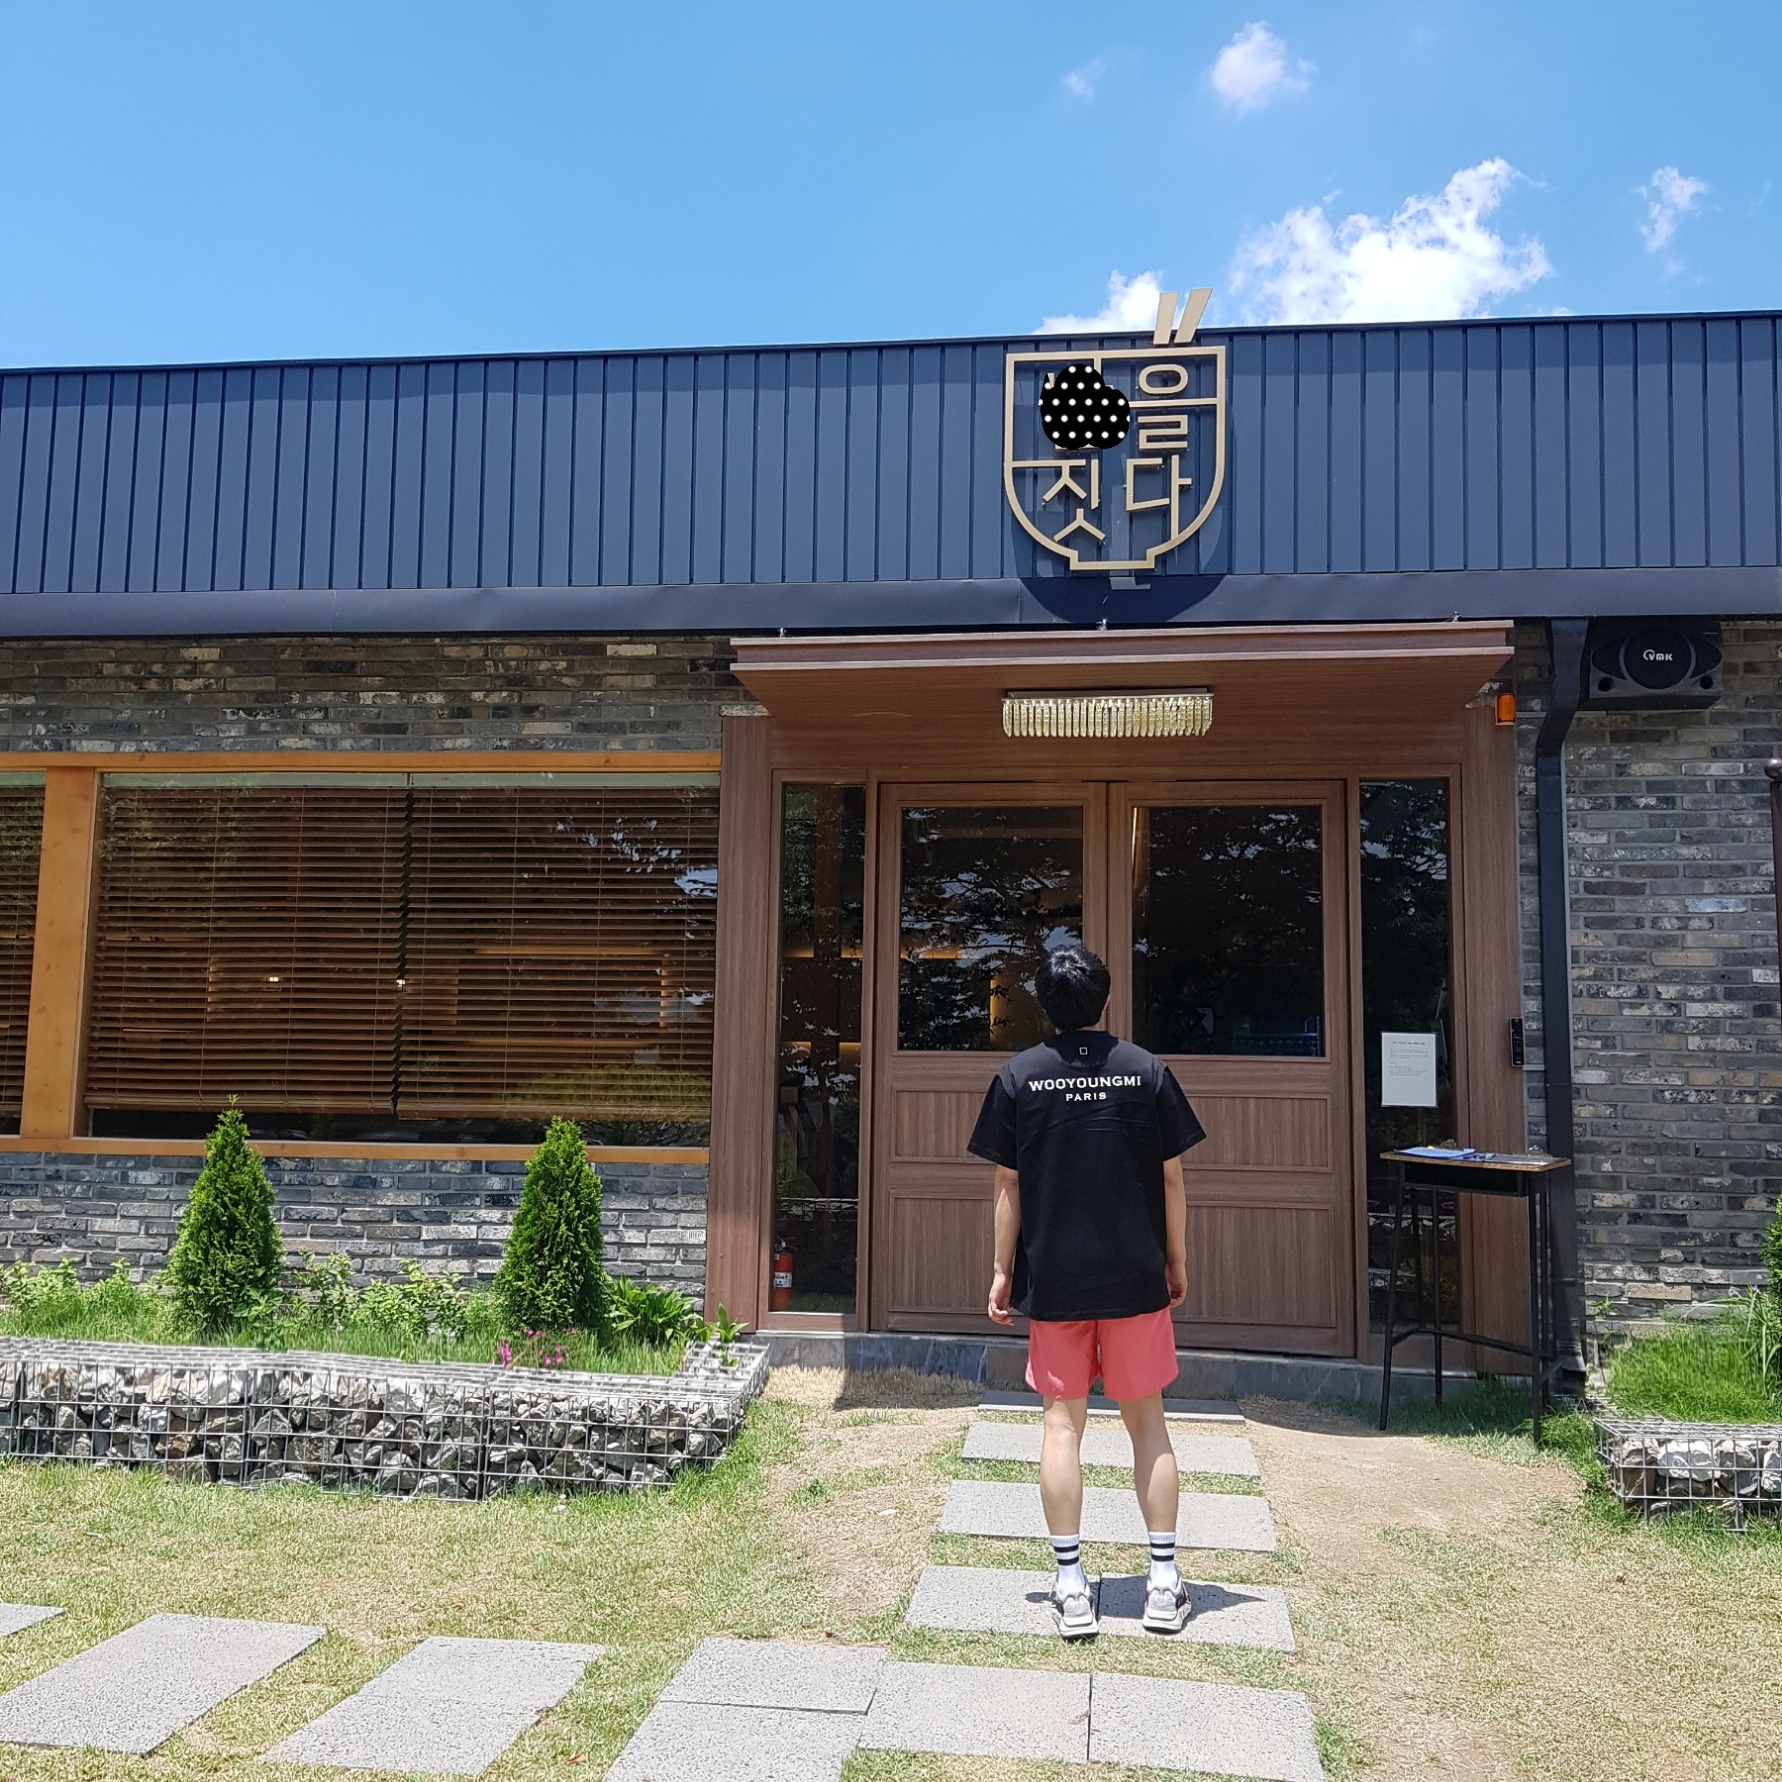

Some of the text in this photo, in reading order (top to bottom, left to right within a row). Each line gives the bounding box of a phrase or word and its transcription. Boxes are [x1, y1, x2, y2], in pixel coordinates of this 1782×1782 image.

[1041, 359, 1215, 450] 을
[1020, 454, 1192, 541] 짓다
[1028, 1075, 1141, 1091] WOOYOUNGMI
[1065, 1092, 1107, 1101] PARIS
